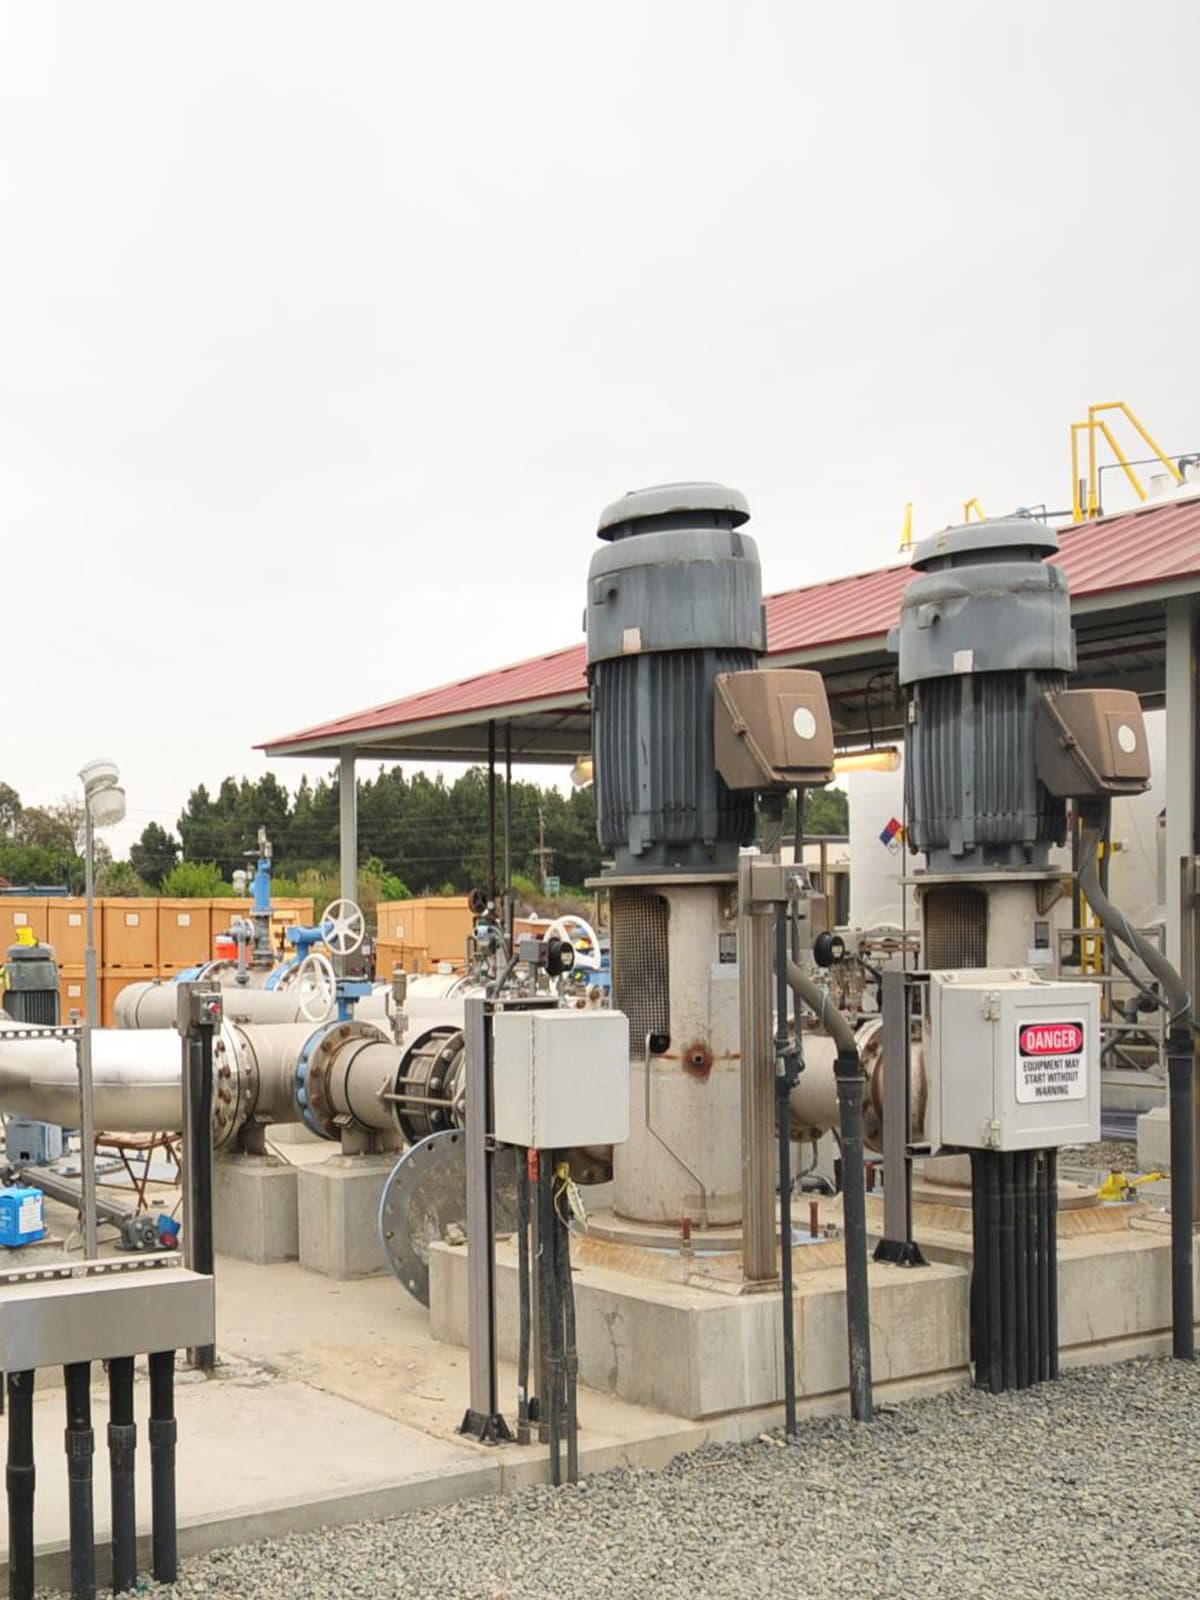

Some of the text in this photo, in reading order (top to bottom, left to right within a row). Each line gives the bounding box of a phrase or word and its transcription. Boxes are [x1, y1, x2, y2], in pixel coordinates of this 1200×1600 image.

[1026, 1030, 1076, 1049] DANGER
[1023, 1059, 1079, 1072] EQUIPMENT MAY
[1024, 1071, 1078, 1084] START WITHOUT
[1035, 1085, 1069, 1096] WARNING
